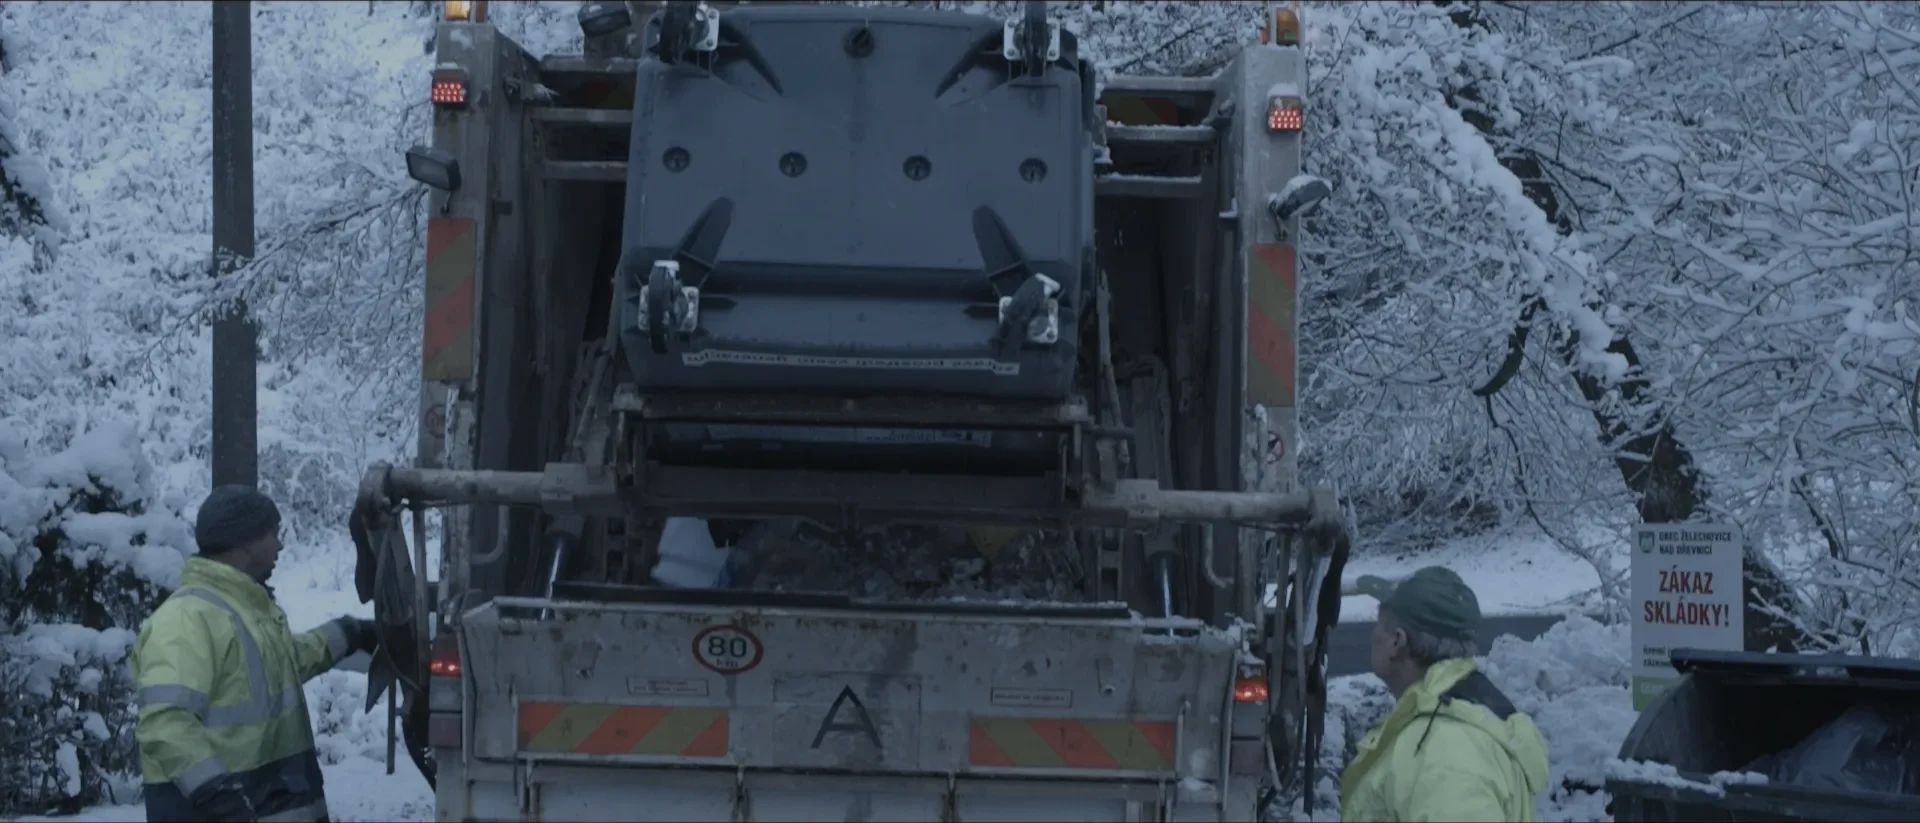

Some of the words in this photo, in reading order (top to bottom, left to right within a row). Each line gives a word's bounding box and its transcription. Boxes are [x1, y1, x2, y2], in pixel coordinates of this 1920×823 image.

[1659, 532, 1679, 542] OBEC
[1680, 529, 1732, 542] ŽELECHOVICE
[1659, 545, 1675, 555] NAD
[1676, 542, 1713, 555] DŘEVNICÍ
[1659, 564, 1714, 595] ZÁKAZ
[1643, 597, 1729, 628] SKLÁDKY!
[708, 636, 747, 658] 80
[811, 684, 884, 749] A
